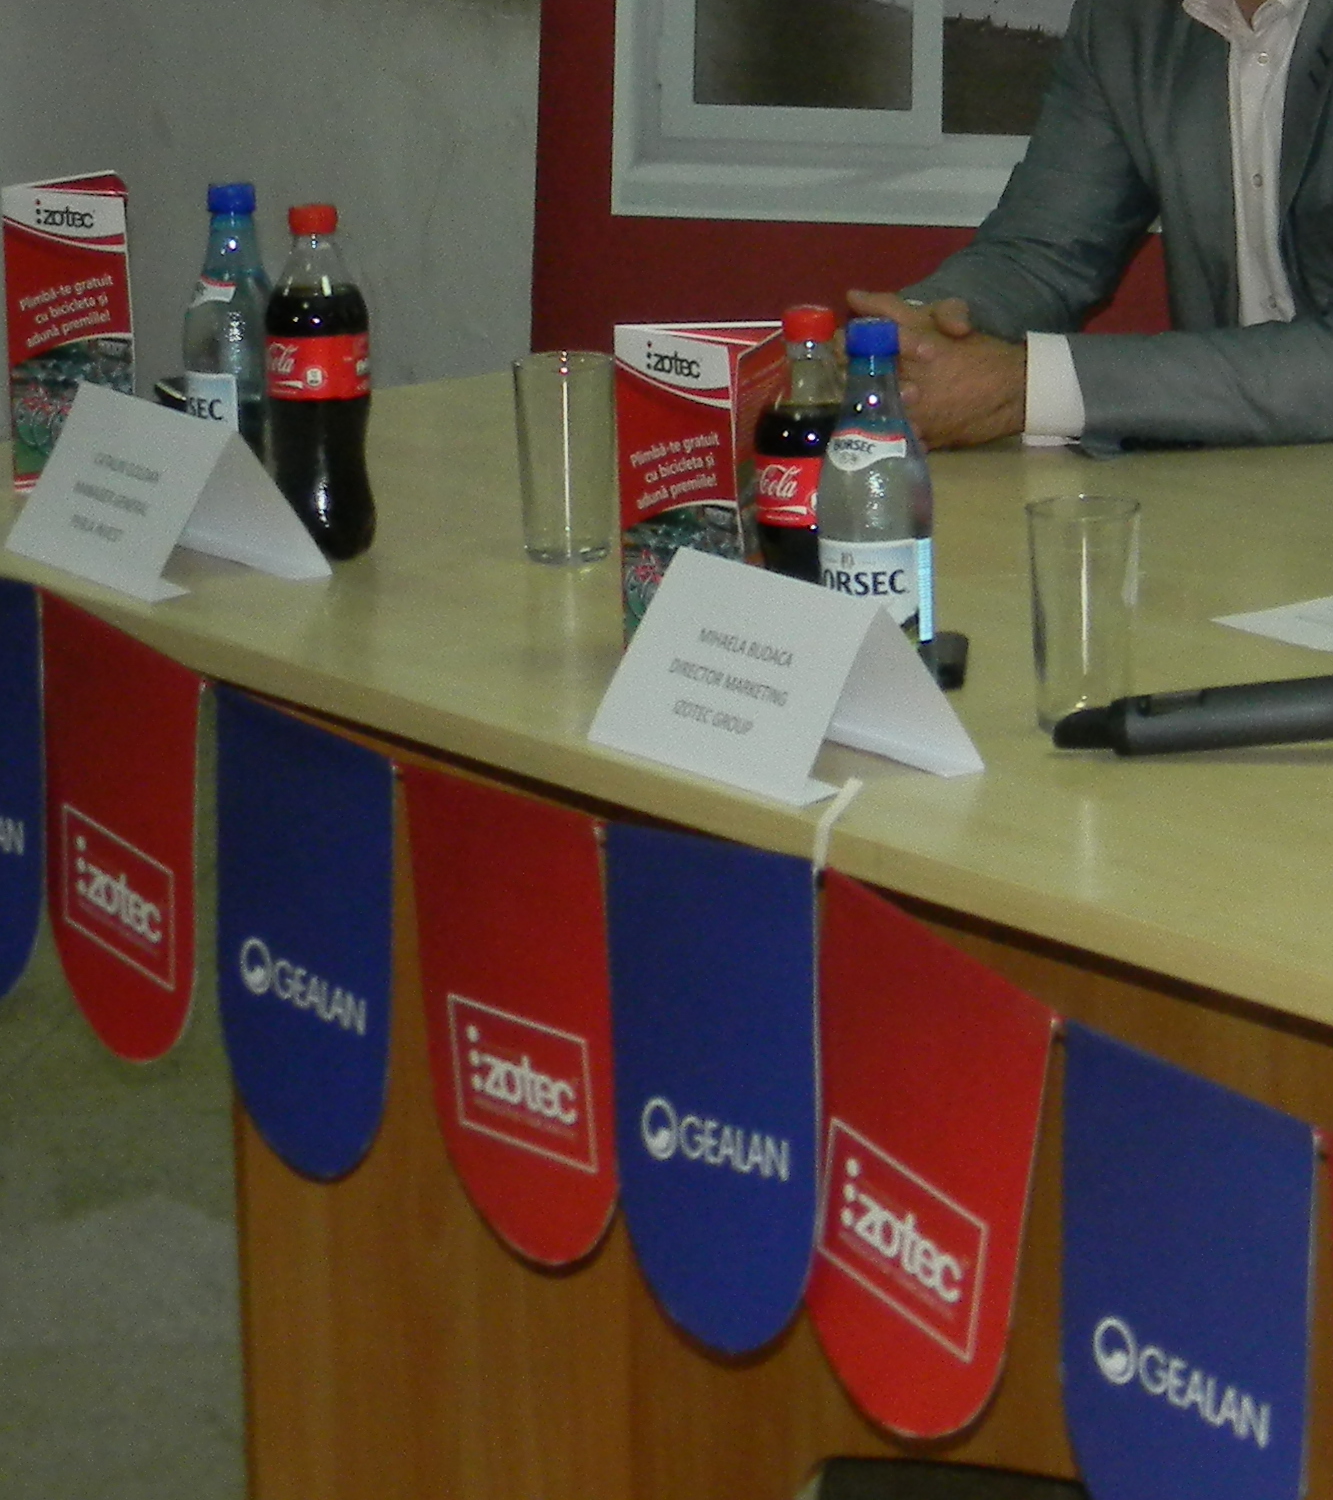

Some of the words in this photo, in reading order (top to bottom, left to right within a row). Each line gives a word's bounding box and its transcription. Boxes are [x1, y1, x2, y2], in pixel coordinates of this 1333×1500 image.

[759, 464, 803, 499] Cola
[678, 1114, 790, 1182] GEALAN
[1139, 1345, 1272, 1449] GEALAN
